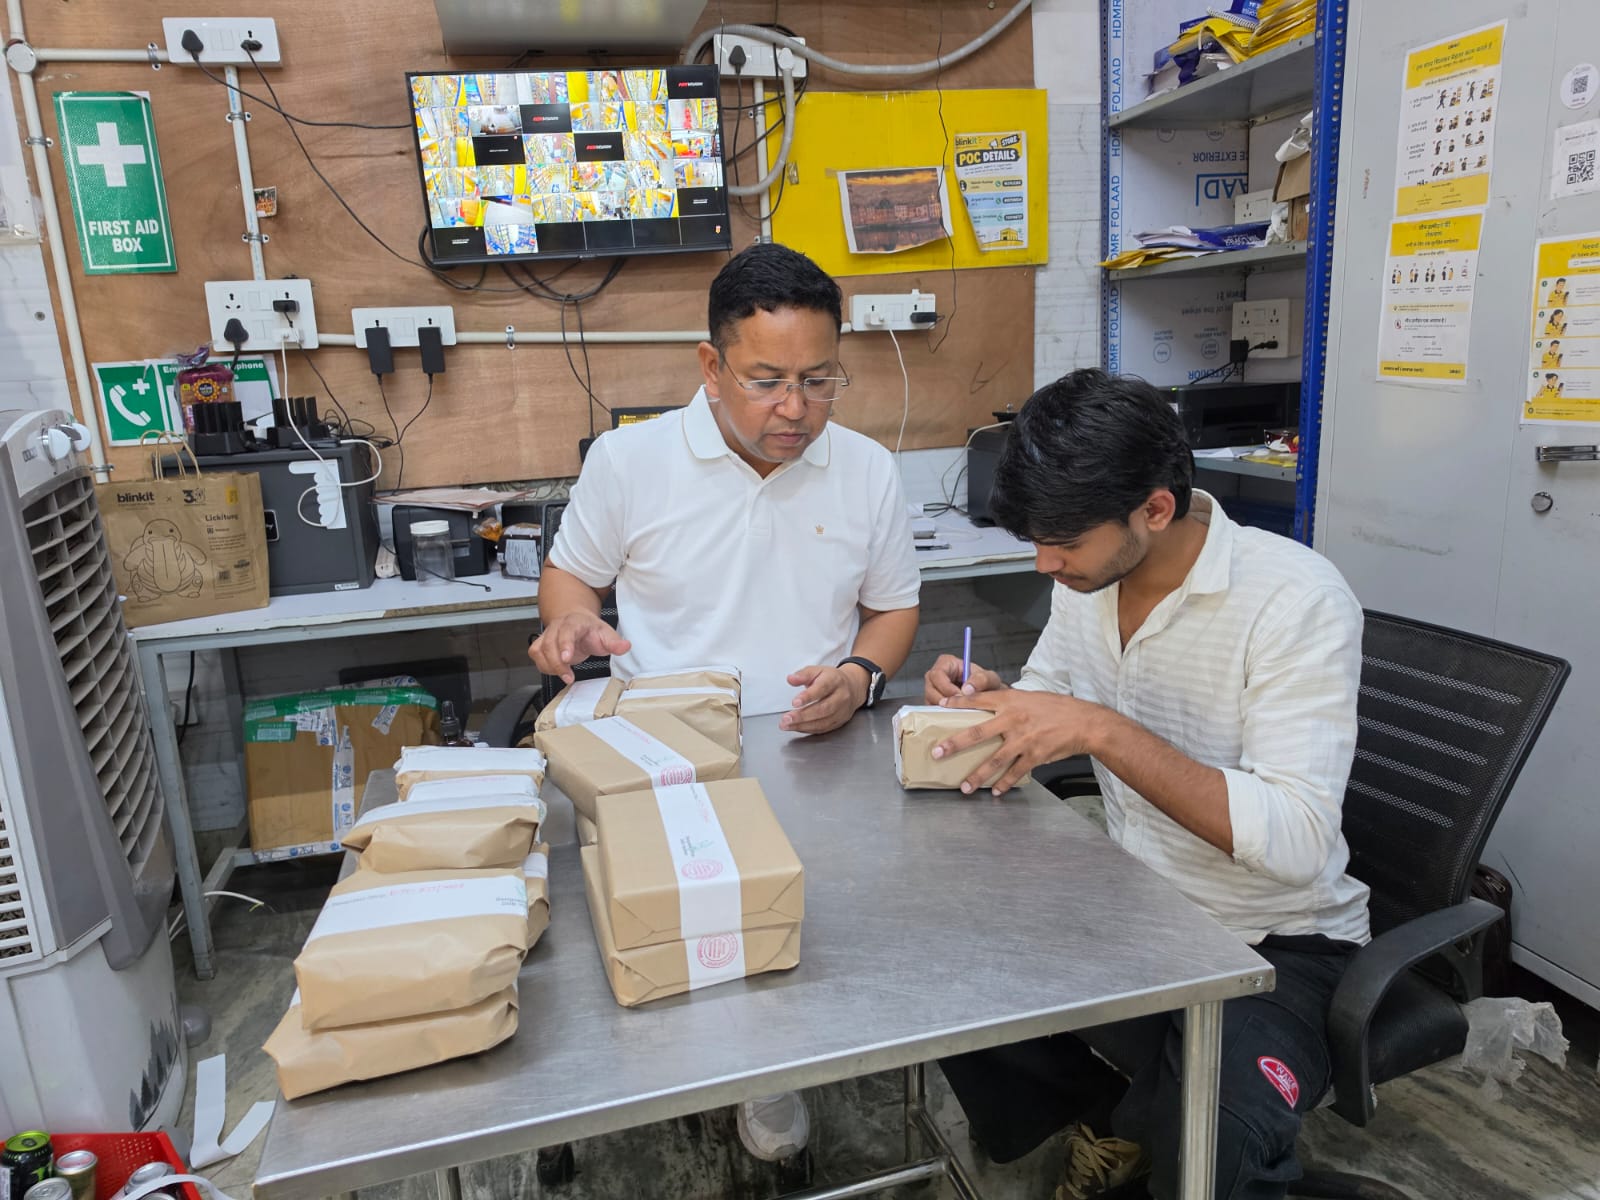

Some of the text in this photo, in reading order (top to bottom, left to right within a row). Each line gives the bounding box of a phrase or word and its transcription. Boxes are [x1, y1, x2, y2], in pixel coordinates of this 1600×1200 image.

[1112, 57, 1121, 112] FOLAAD
[1001, 135, 1018, 147] STORE
[959, 150, 1016, 165] POC DETAILS
[1193, 151, 1237, 162] EXTERIOR
[1111, 175, 1120, 228] FOLAAD
[88, 218, 159, 236] FIRST AID
[112, 236, 143, 253] BOX
[1110, 287, 1119, 339] FOLAAD
[116, 491, 155, 504] blinkit
[205, 513, 240, 523] Lickitung
